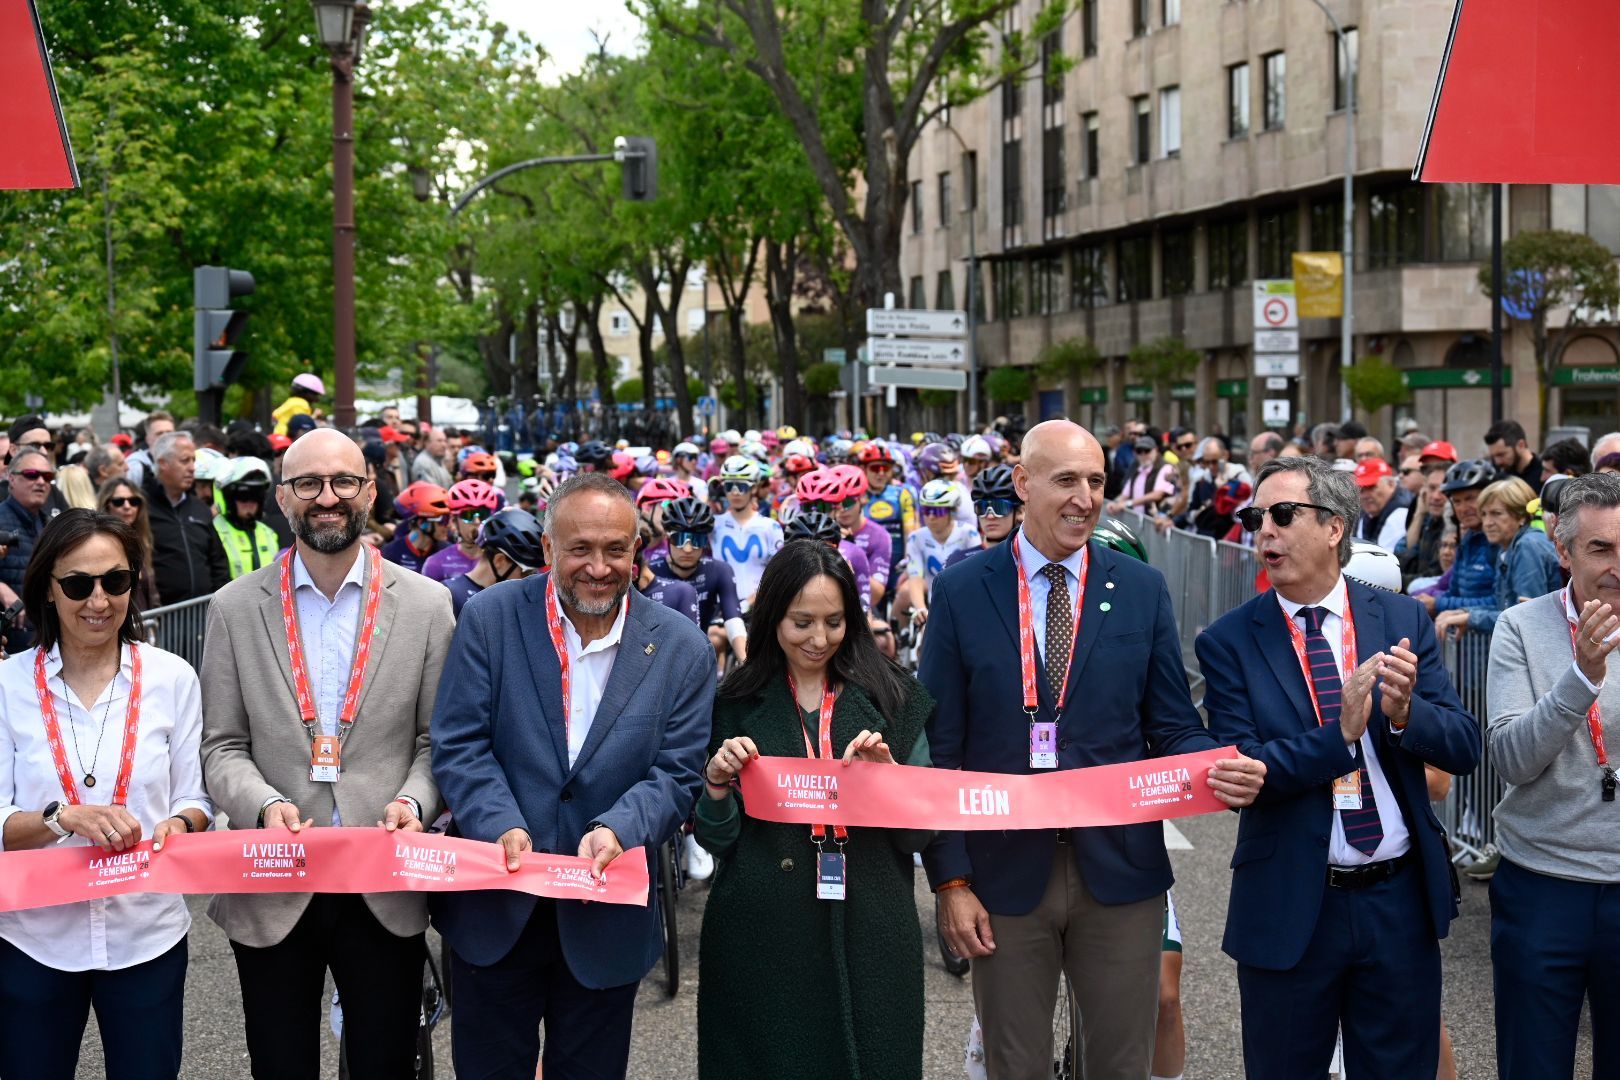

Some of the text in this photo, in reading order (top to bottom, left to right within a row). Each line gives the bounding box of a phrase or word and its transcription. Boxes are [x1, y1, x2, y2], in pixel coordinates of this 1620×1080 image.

[777, 773, 838, 790] LA VUELTA
[1129, 768, 1190, 789] LA VUELTA
[788, 790, 838, 800] FEMENINA 26
[1141, 782, 1192, 797] FEMENINA 26
[784, 801, 825, 809] Carrefour.es
[959, 784, 1010, 815] LEÓN
[243, 843, 306, 858] LA VUELTA
[395, 844, 457, 866] LA VUELTA
[89, 850, 150, 869] LA VUELTA
[253, 858, 306, 868] FEMENINA 26
[404, 859, 456, 875] FEMENINA 26
[99, 861, 149, 877] FEMENINA 26
[563, 867, 607, 883] VUELA
[556, 872, 595, 886] FEMENINA
